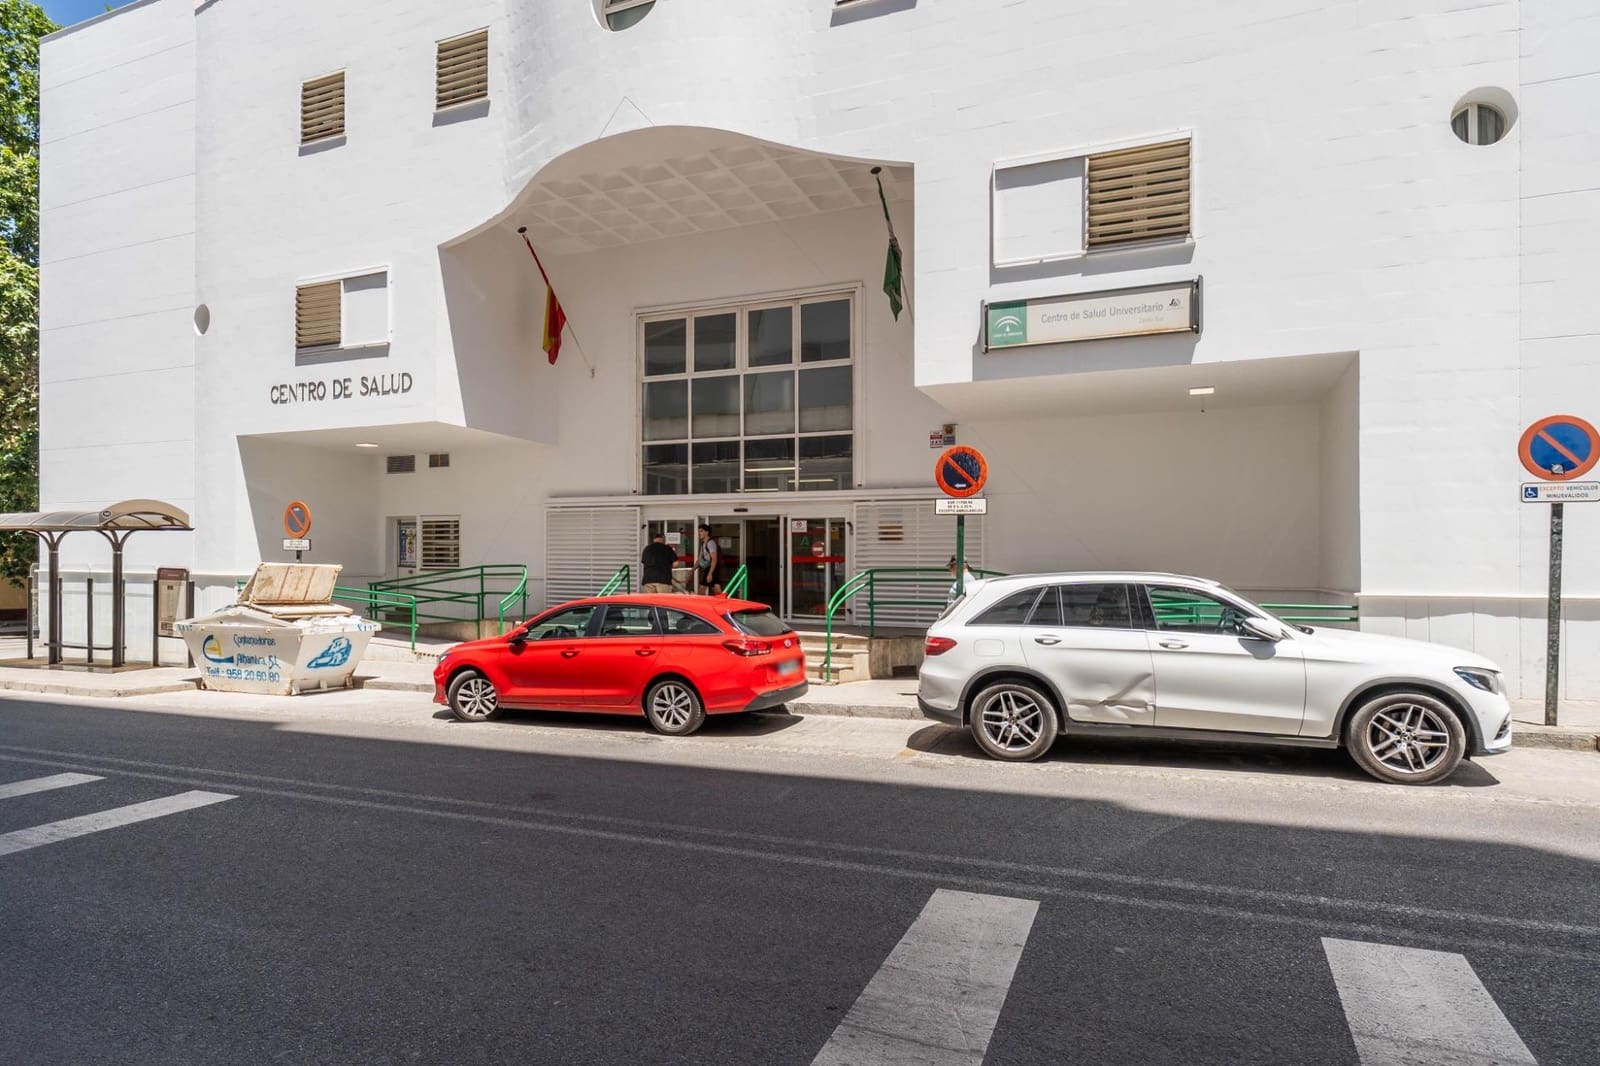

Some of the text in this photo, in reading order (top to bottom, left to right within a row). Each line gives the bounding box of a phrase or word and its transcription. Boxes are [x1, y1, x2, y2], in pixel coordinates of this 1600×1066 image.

[1041, 312, 1068, 324] Centro
[1070, 311, 1081, 321] de
[1083, 307, 1107, 319] Salud
[1109, 303, 1164, 317] Universitario
[270, 372, 413, 405] CENTRO DE SALUD
[226, 668, 243, 680] 958
[244, 669, 255, 681] 20
[256, 670, 267, 682] 60
[269, 671, 280, 683] 80
